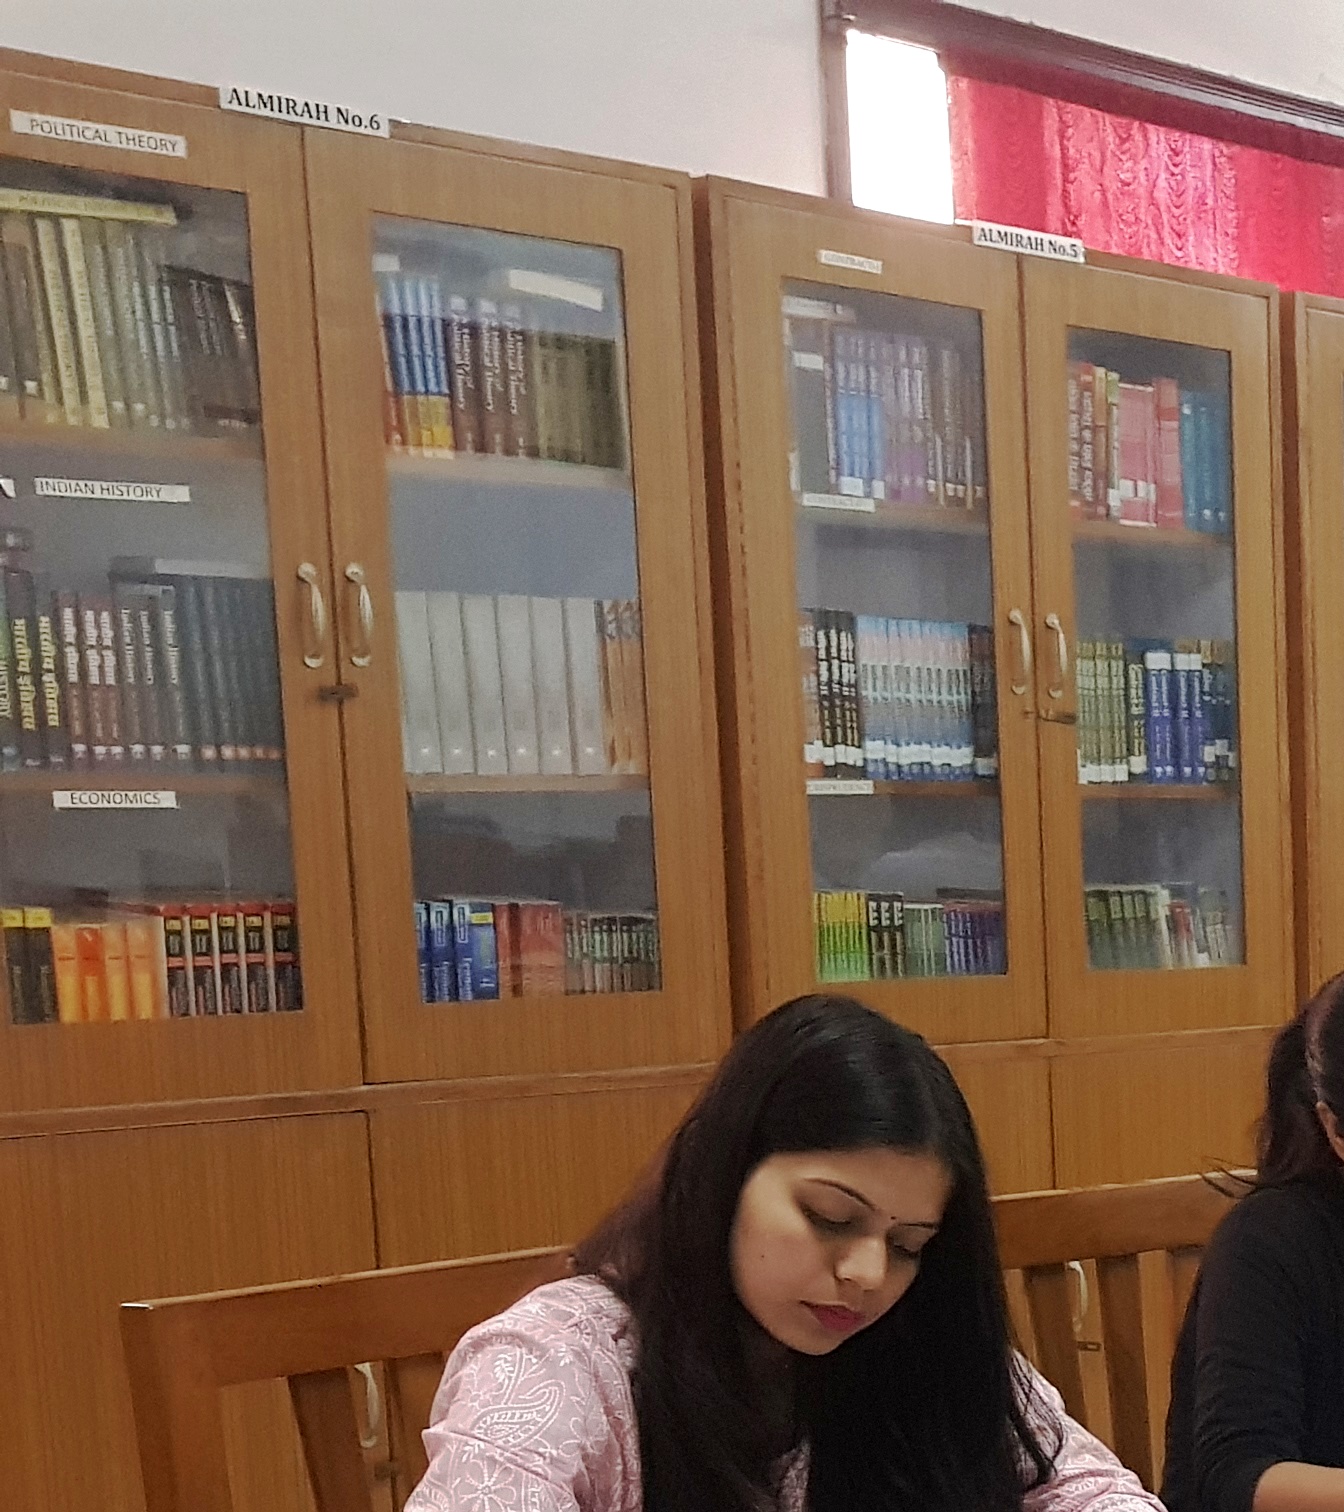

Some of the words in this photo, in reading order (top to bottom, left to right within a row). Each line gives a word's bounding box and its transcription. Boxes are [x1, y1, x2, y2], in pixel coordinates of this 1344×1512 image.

[227, 87, 330, 122] ALMIRAH
[335, 106, 381, 132] No.6
[29, 117, 111, 145] POLITICAL
[116, 130, 178, 153] THEORY
[977, 227, 1045, 252] ALMIRAH
[1048, 239, 1078, 258] No.5
[39, 480, 95, 495] INDIAN
[100, 484, 163, 498] HISTORY
[70, 792, 161, 805] ECONOMICS
